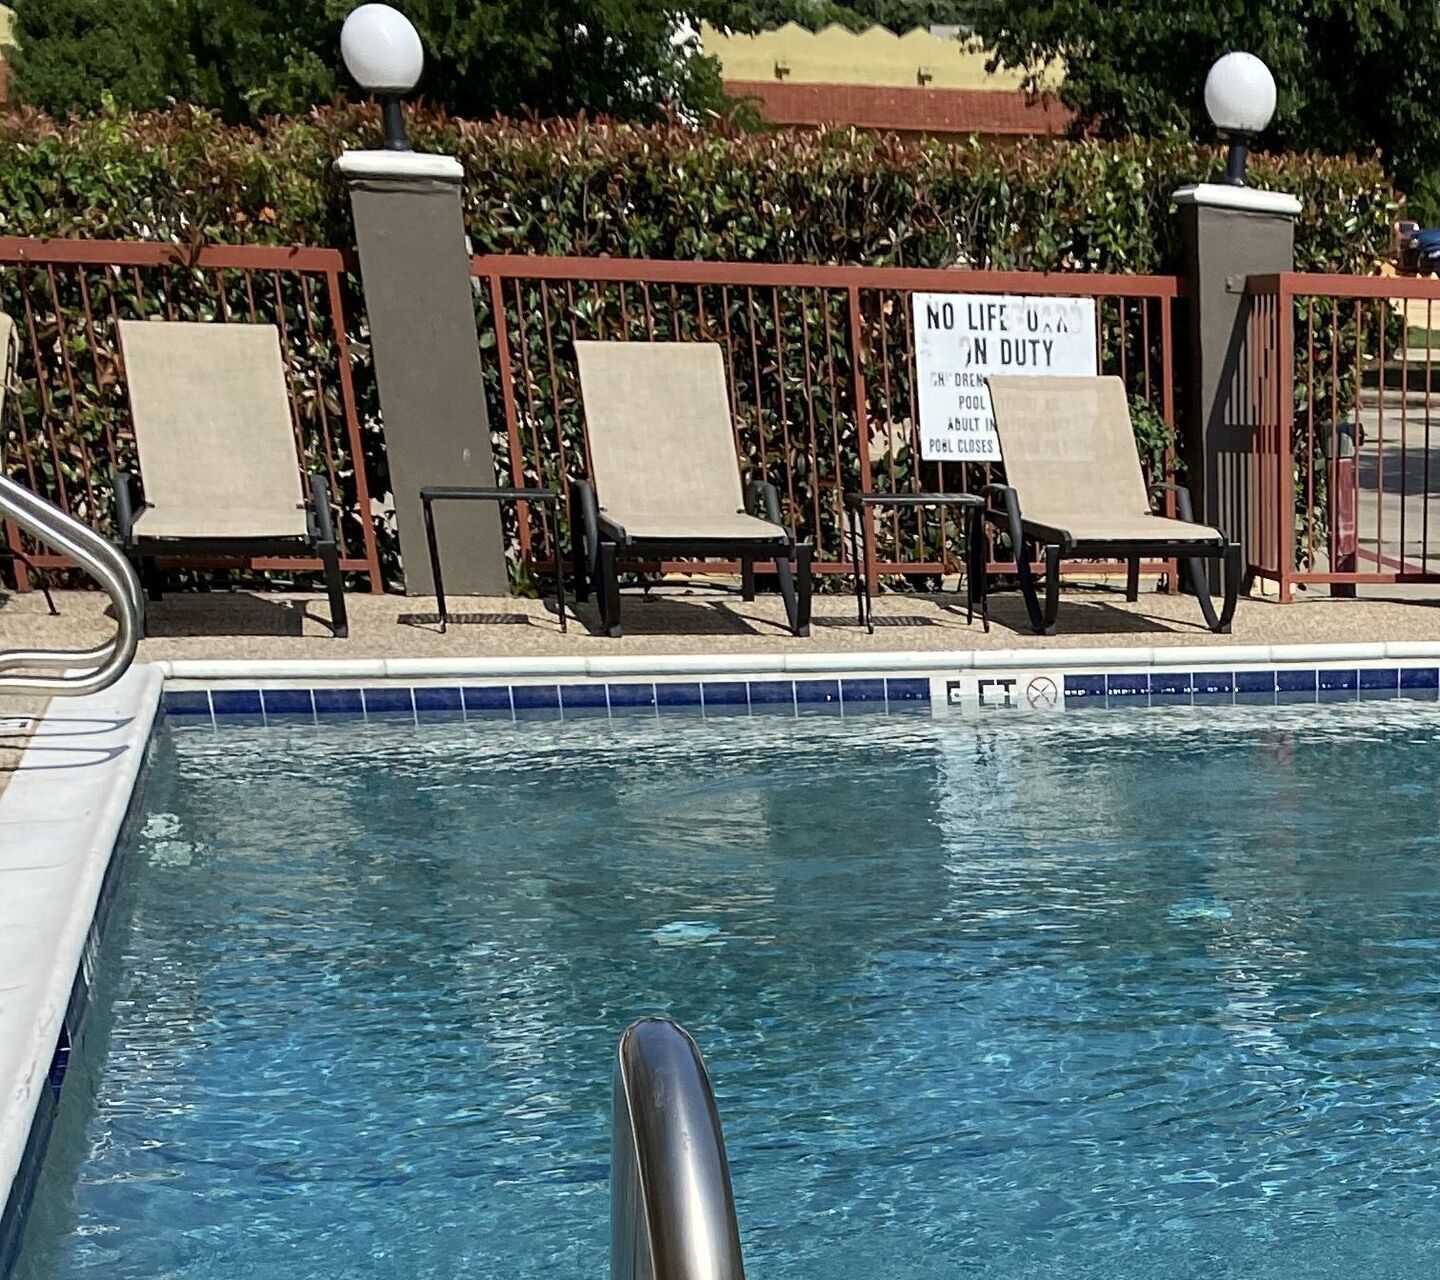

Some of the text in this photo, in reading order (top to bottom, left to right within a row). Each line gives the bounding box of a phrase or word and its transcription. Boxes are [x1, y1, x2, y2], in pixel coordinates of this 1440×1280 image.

[926, 303, 954, 330] NO
[1001, 338, 1053, 367] DUTY
[959, 395, 986, 410] POOL
[929, 439, 993, 453] POOL CLOSES
